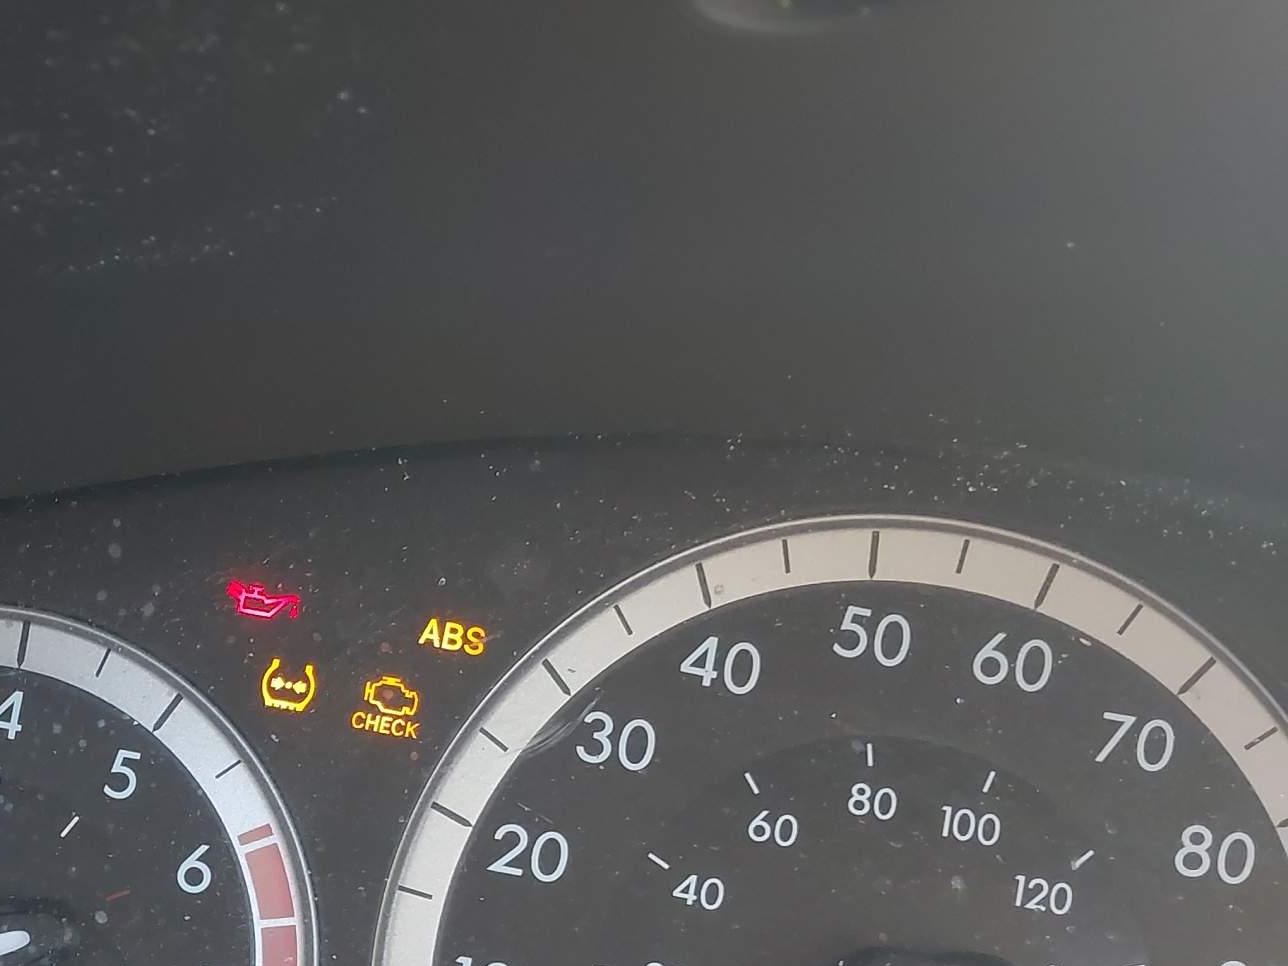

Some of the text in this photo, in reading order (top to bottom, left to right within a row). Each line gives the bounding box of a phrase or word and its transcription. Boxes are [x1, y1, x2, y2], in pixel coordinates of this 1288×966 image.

[418, 618, 486, 656] ABS
[833, 605, 911, 667] 50
[680, 636, 761, 695] 40
[972, 632, 1053, 692] 60
[350, 711, 420, 740] CHECK
[576, 711, 656, 771] 30
[1094, 711, 1174, 772] 70
[103, 749, 141, 799] 5
[848, 783, 897, 820] 80
[940, 806, 1000, 846] 100
[487, 824, 569, 883] 20
[747, 810, 798, 847] 60
[176, 844, 211, 894] 6
[1174, 824, 1255, 885] 80
[672, 875, 724, 910] 40
[1014, 875, 1073, 915] 120
